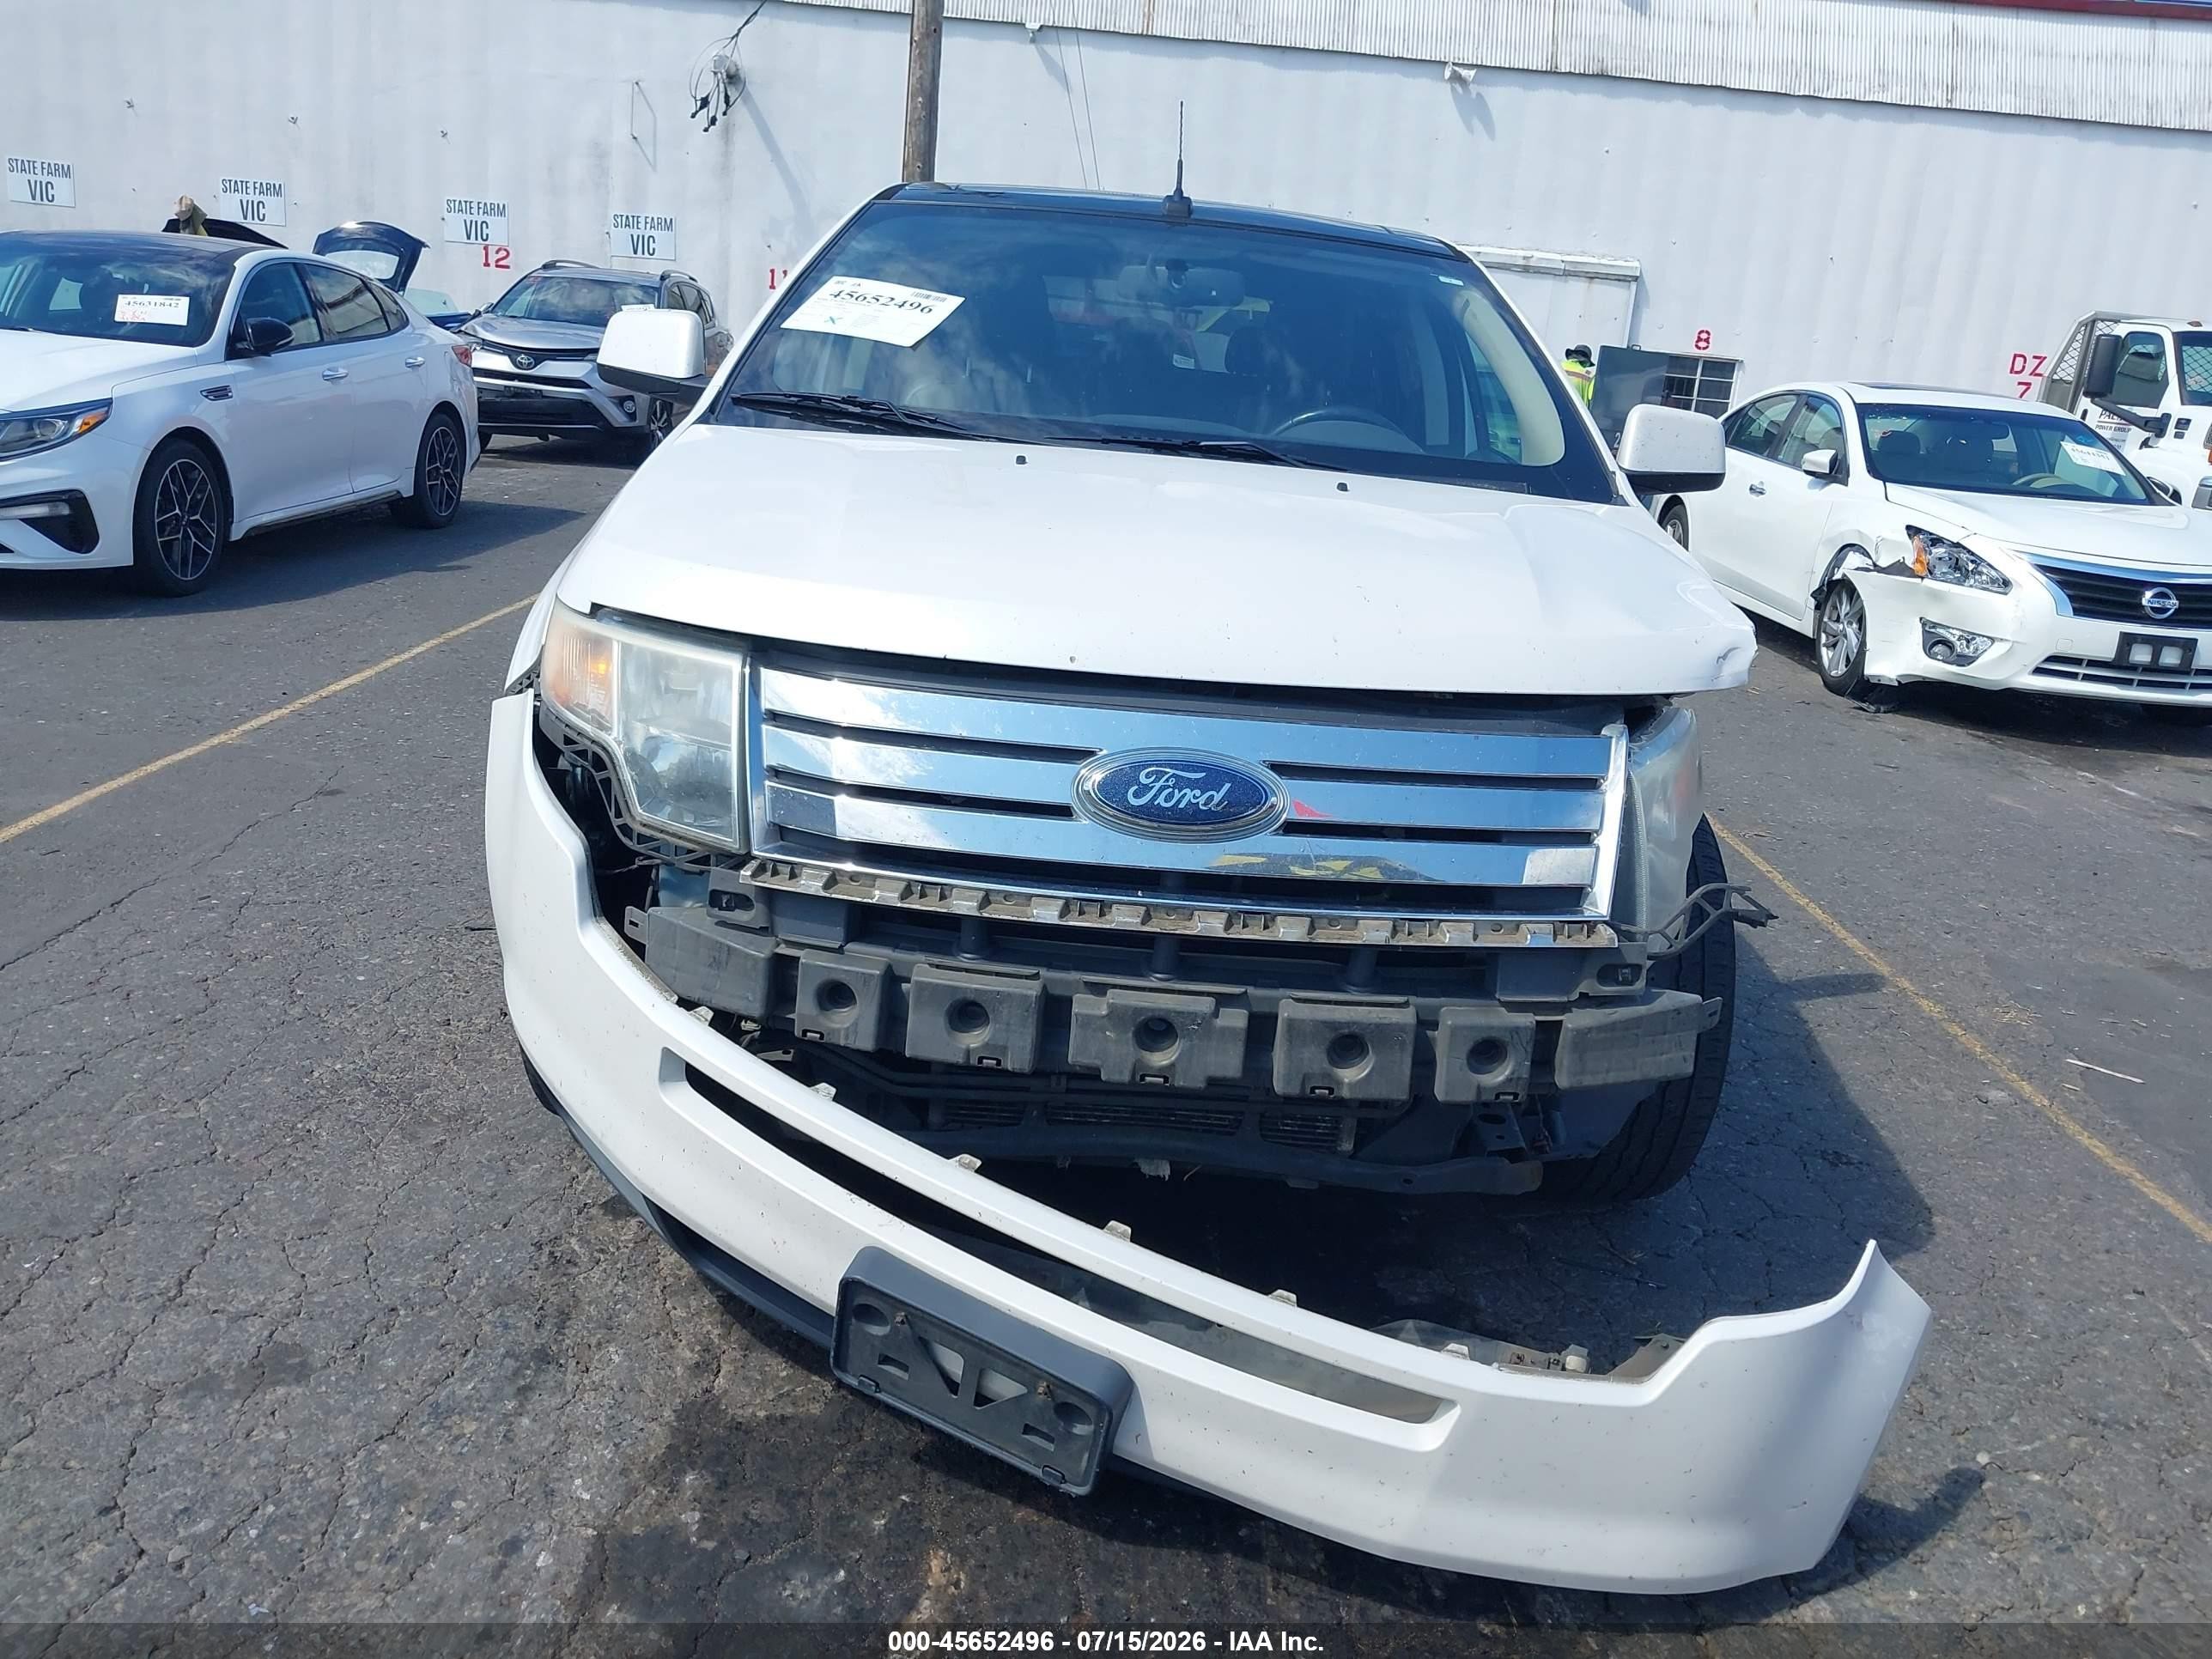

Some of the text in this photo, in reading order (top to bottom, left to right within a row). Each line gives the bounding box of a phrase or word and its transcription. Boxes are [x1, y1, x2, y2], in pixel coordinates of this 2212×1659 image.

[8, 158, 71, 179] STATE FARM
[27, 179, 55, 203] VIC
[222, 179, 283, 198] STATE FARM
[240, 199, 266, 222] VIC
[447, 199, 507, 218] STATE FARM
[464, 220, 489, 242] VIC
[613, 214, 673, 232] STATE FARM
[630, 234, 656, 256] VIC
[483, 245, 510, 269] 12
[769, 269, 787, 290] 1
[830, 289, 934, 314] 45652496
[1694, 330, 1711, 350] 8
[2009, 353, 2047, 377] DZ
[2016, 381, 2032, 398] 7
[1127, 767, 1231, 811] Ford
